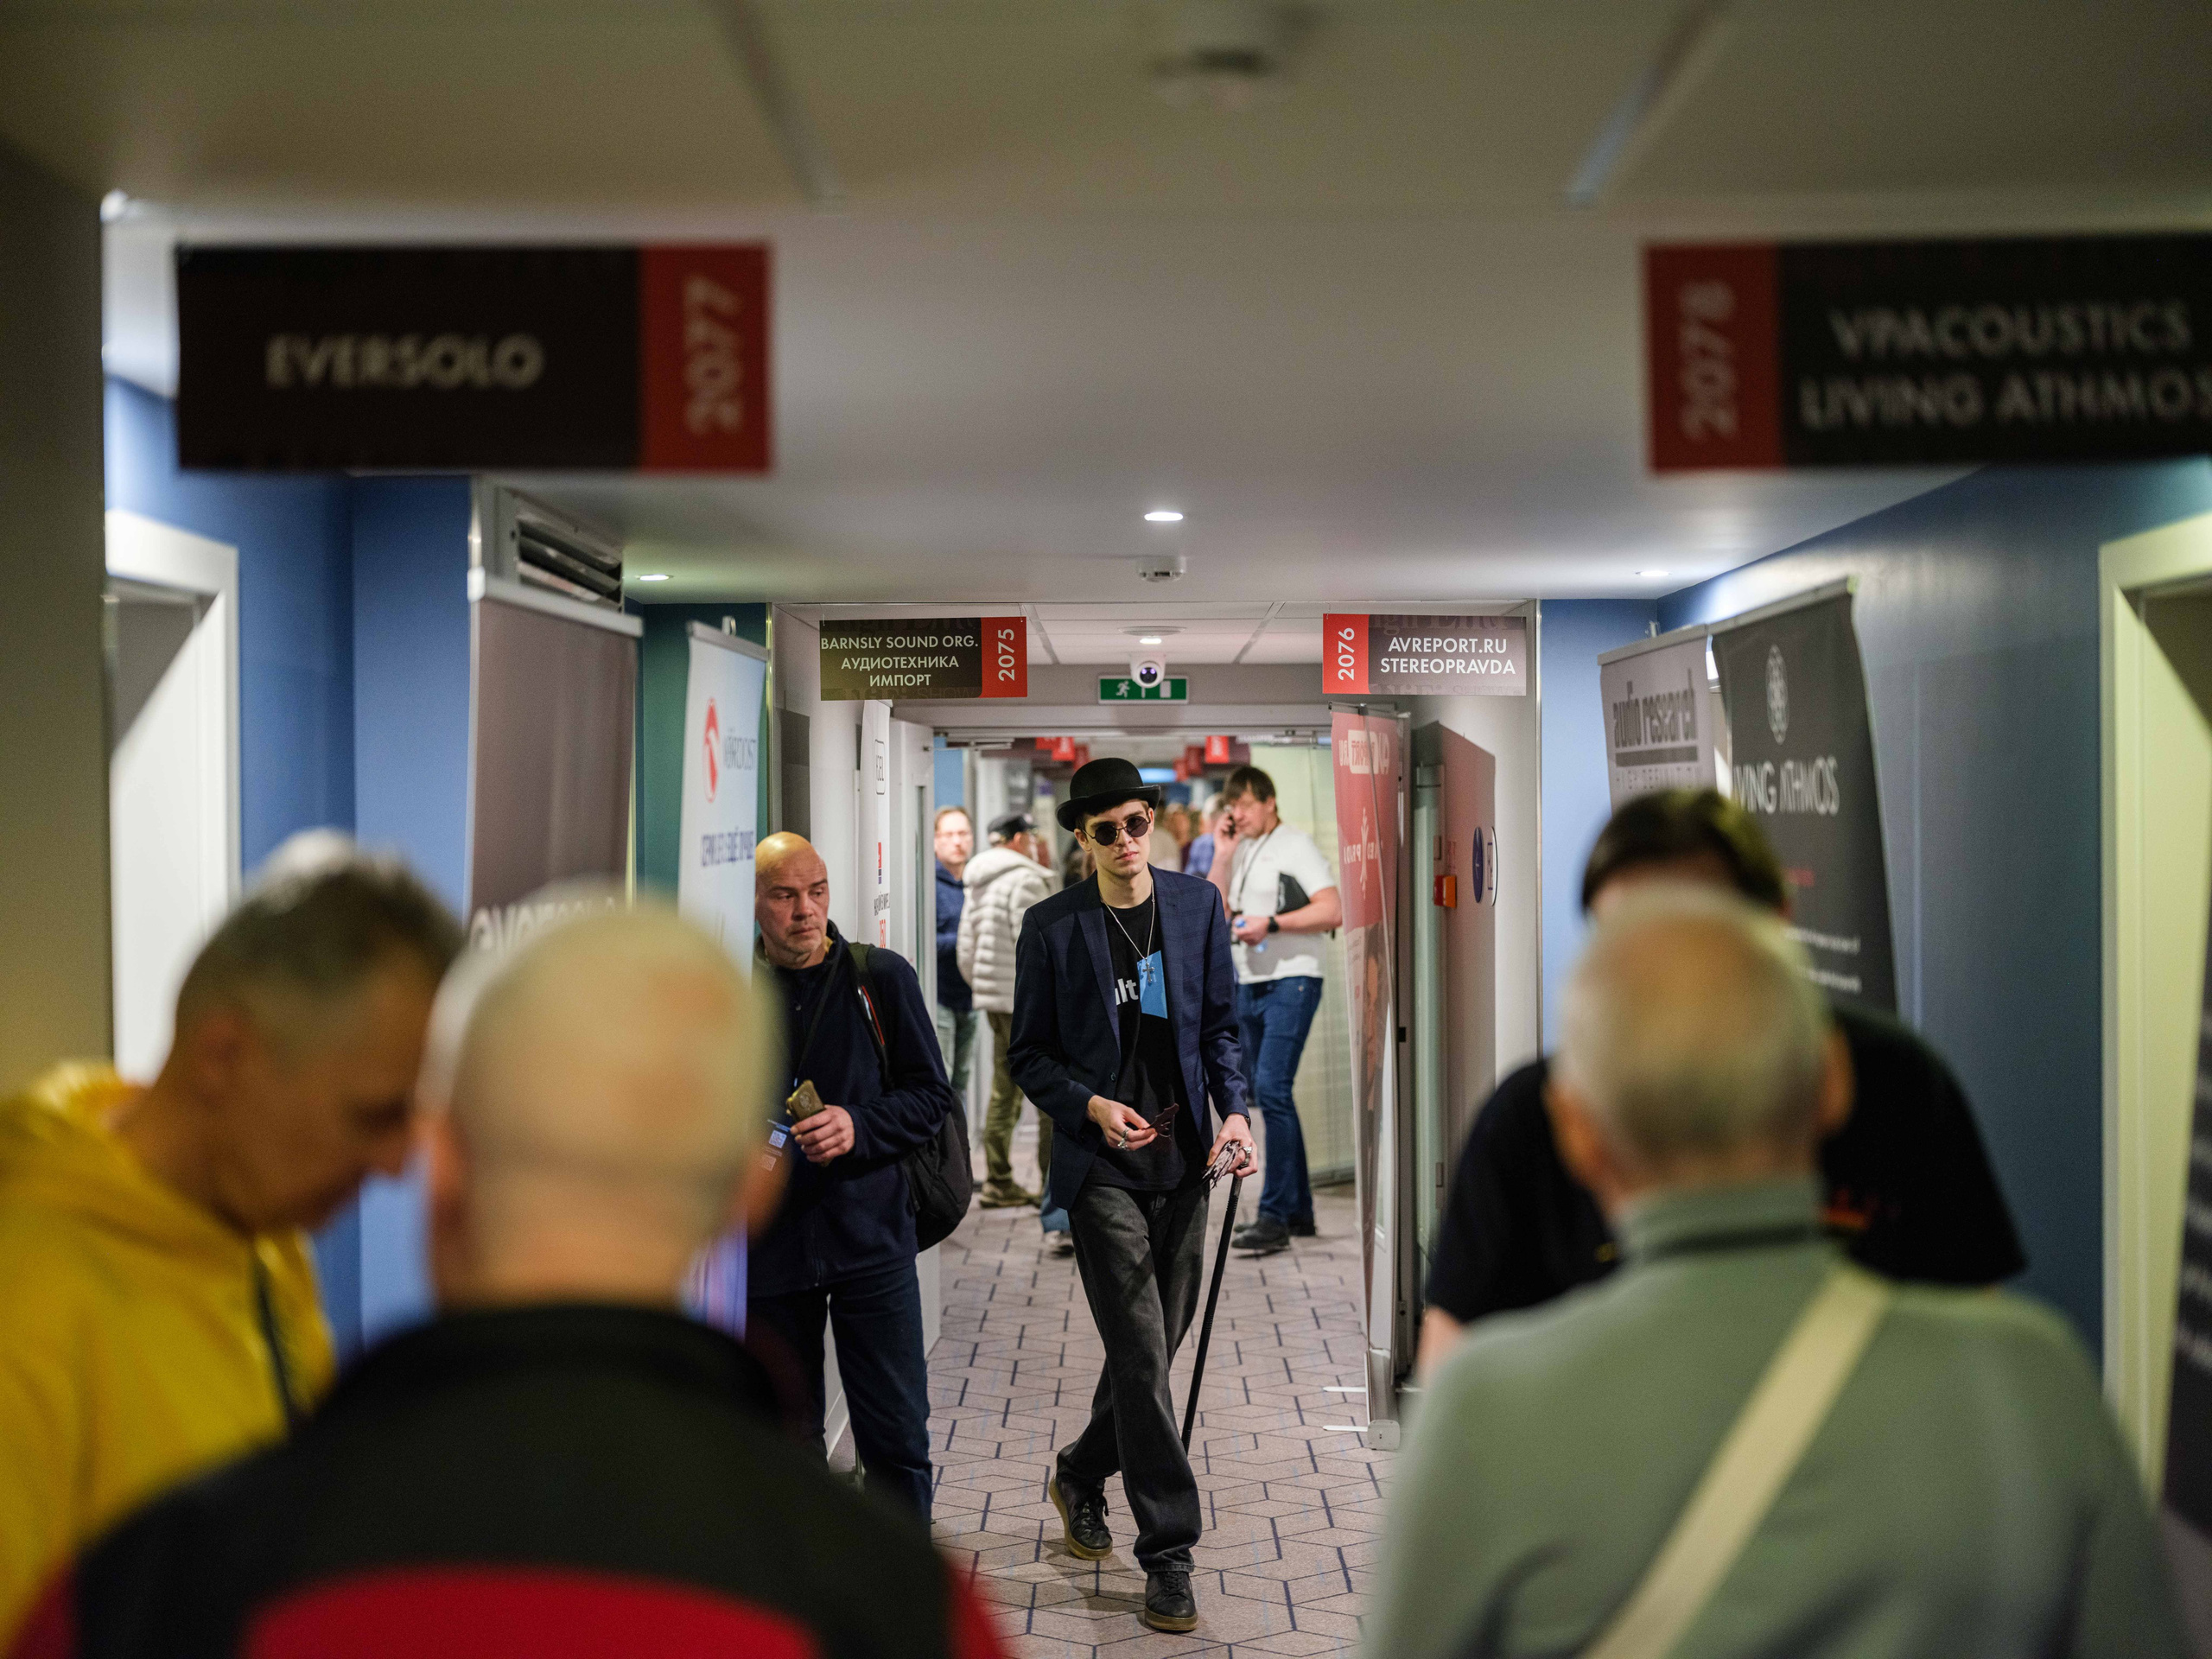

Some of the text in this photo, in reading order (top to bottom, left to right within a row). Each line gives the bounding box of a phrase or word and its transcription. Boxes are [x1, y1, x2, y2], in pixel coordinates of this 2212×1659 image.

[265, 334, 544, 389] EVERSOLO
[1800, 374, 1983, 429] LIVING
[821, 635, 979, 650] BARNSLY SOUND ORG.
[998, 629, 1015, 682] 2075
[1338, 627, 1355, 681] 2076
[1388, 637, 1507, 653] AVREPORT.RU
[841, 656, 959, 671] АУДИОТЕХНИКА
[869, 674, 931, 687] ИМПОРТ
[1380, 658, 1516, 675] STEREOPRAVDA
[1612, 681, 1642, 748] audio
